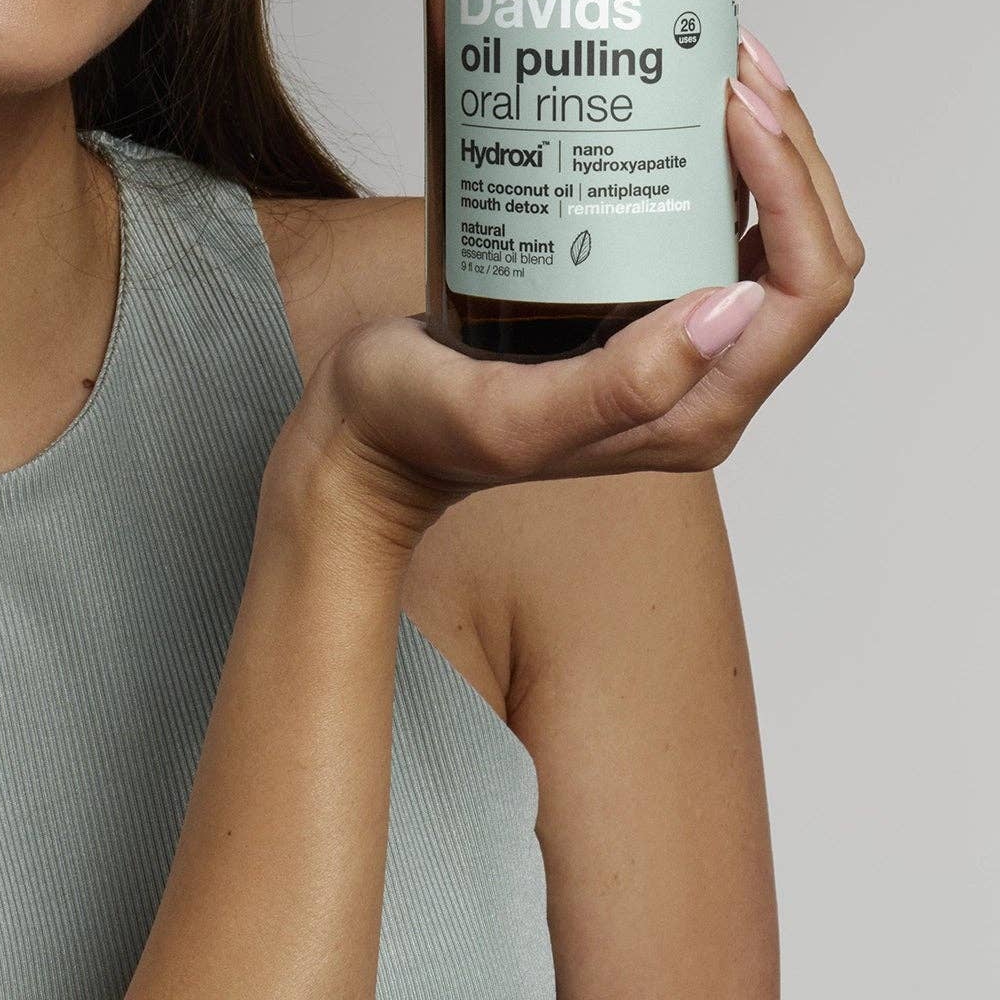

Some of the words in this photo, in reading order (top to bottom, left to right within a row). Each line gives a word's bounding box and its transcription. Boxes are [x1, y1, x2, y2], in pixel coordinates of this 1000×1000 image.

[681, 18, 695, 32] 26
[679, 35, 697, 44] uses
[461, 36, 500, 73] oil
[516, 40, 663, 84] pulling
[461, 84, 520, 120] oral
[536, 85, 633, 122] rinse
[572, 144, 614, 156] nano
[572, 155, 687, 175] hydroxyapatite
[461, 178, 484, 193] mct
[487, 182, 549, 197] coconut
[554, 183, 573, 197] oil
[587, 182, 670, 199] antiplaque
[461, 195, 501, 211] mouth
[505, 199, 549, 214] detox
[567, 198, 691, 216] remineralization
[461, 221, 505, 237] natural
[461, 236, 514, 251] coconut
[519, 239, 554, 253] mint
[461, 248, 500, 261] essential
[505, 251, 518, 263] oil
[520, 252, 554, 265] blend
[461, 262, 466, 272] 9
[468, 263, 474, 273] fl
[474, 266, 485, 274] oz
[492, 265, 511, 276] 266
[512, 266, 524, 278] ml
